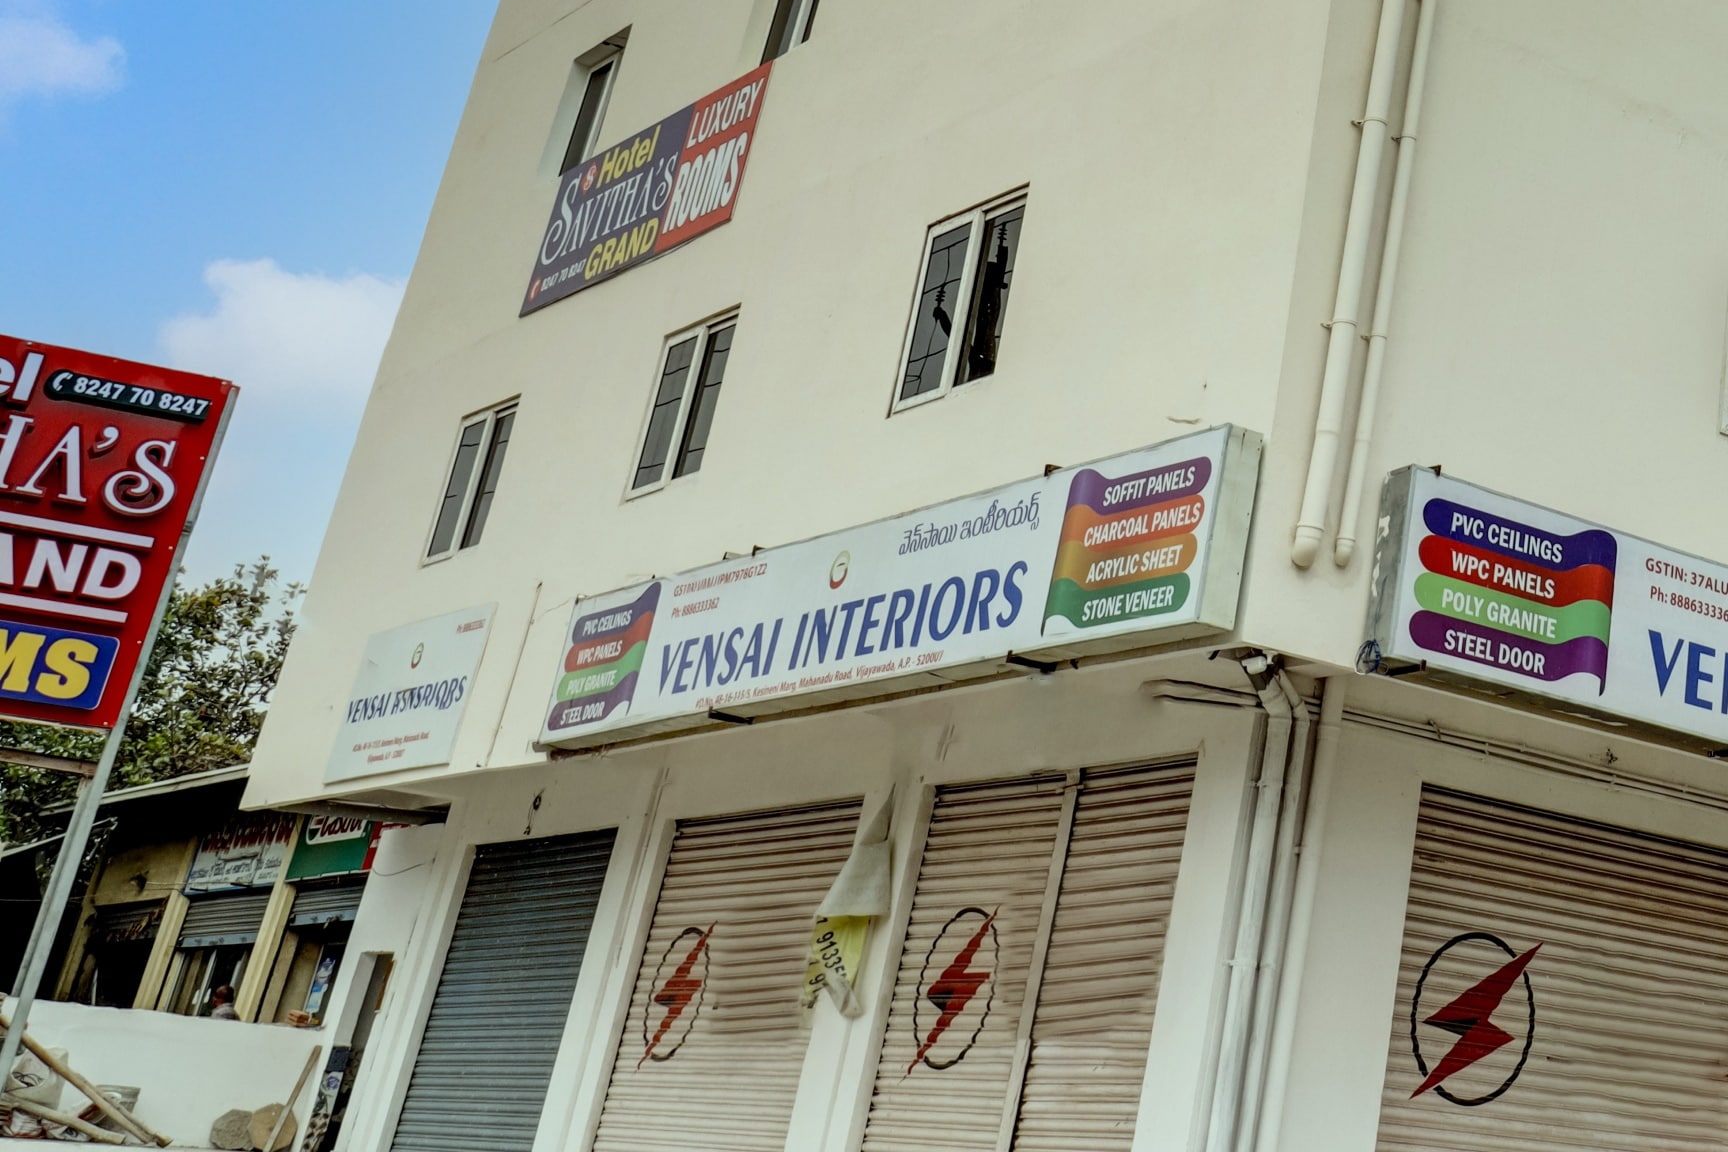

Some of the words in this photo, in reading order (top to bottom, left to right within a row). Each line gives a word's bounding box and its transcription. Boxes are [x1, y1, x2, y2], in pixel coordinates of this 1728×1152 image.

[686, 77, 764, 149] LUXURY
[596, 125, 662, 189] Hotel
[662, 132, 748, 234] ROOMS
[584, 218, 659, 280] GRAND
[74, 377, 125, 400] 8247
[130, 387, 154, 406] 70
[158, 394, 208, 416] 8247
[1103, 478, 1147, 506] SOFFIT
[1146, 466, 1196, 497] PANELS
[1083, 521, 1149, 547] CHARCOAL
[1151, 503, 1201, 532] PANELS
[1451, 512, 1484, 539] PVC
[1487, 523, 1563, 564] CEILINGS
[1085, 554, 1140, 583] ACRYLIC
[1141, 544, 1183, 572] SHEET
[1451, 550, 1490, 581] WPC
[1493, 563, 1555, 599] PANELS
[1645, 557, 1688, 583] GSTIN:
[1082, 595, 1124, 622] STONE
[1125, 585, 1175, 613] VENEER
[1441, 588, 1484, 618] POLY
[1487, 601, 1558, 639] GRANITE
[1650, 586, 1668, 604] Ph:
[582, 618, 599, 637] PVC
[598, 610, 632, 633] CEILINGS
[659, 617, 784, 697] VENSAI
[788, 560, 1028, 671] INTERIORS
[577, 648, 594, 665] WPC
[593, 640, 623, 662] PANELS
[856, 661, 896, 679] Vijayawada,
[1444, 629, 1494, 662] STEEL
[1498, 643, 1546, 675] DOOR
[566, 676, 585, 694] POLY
[584, 670, 618, 690] GRANITE
[346, 691, 392, 724] VENSAI
[560, 708, 584, 725] STEEL
[582, 701, 605, 721] DOOR
